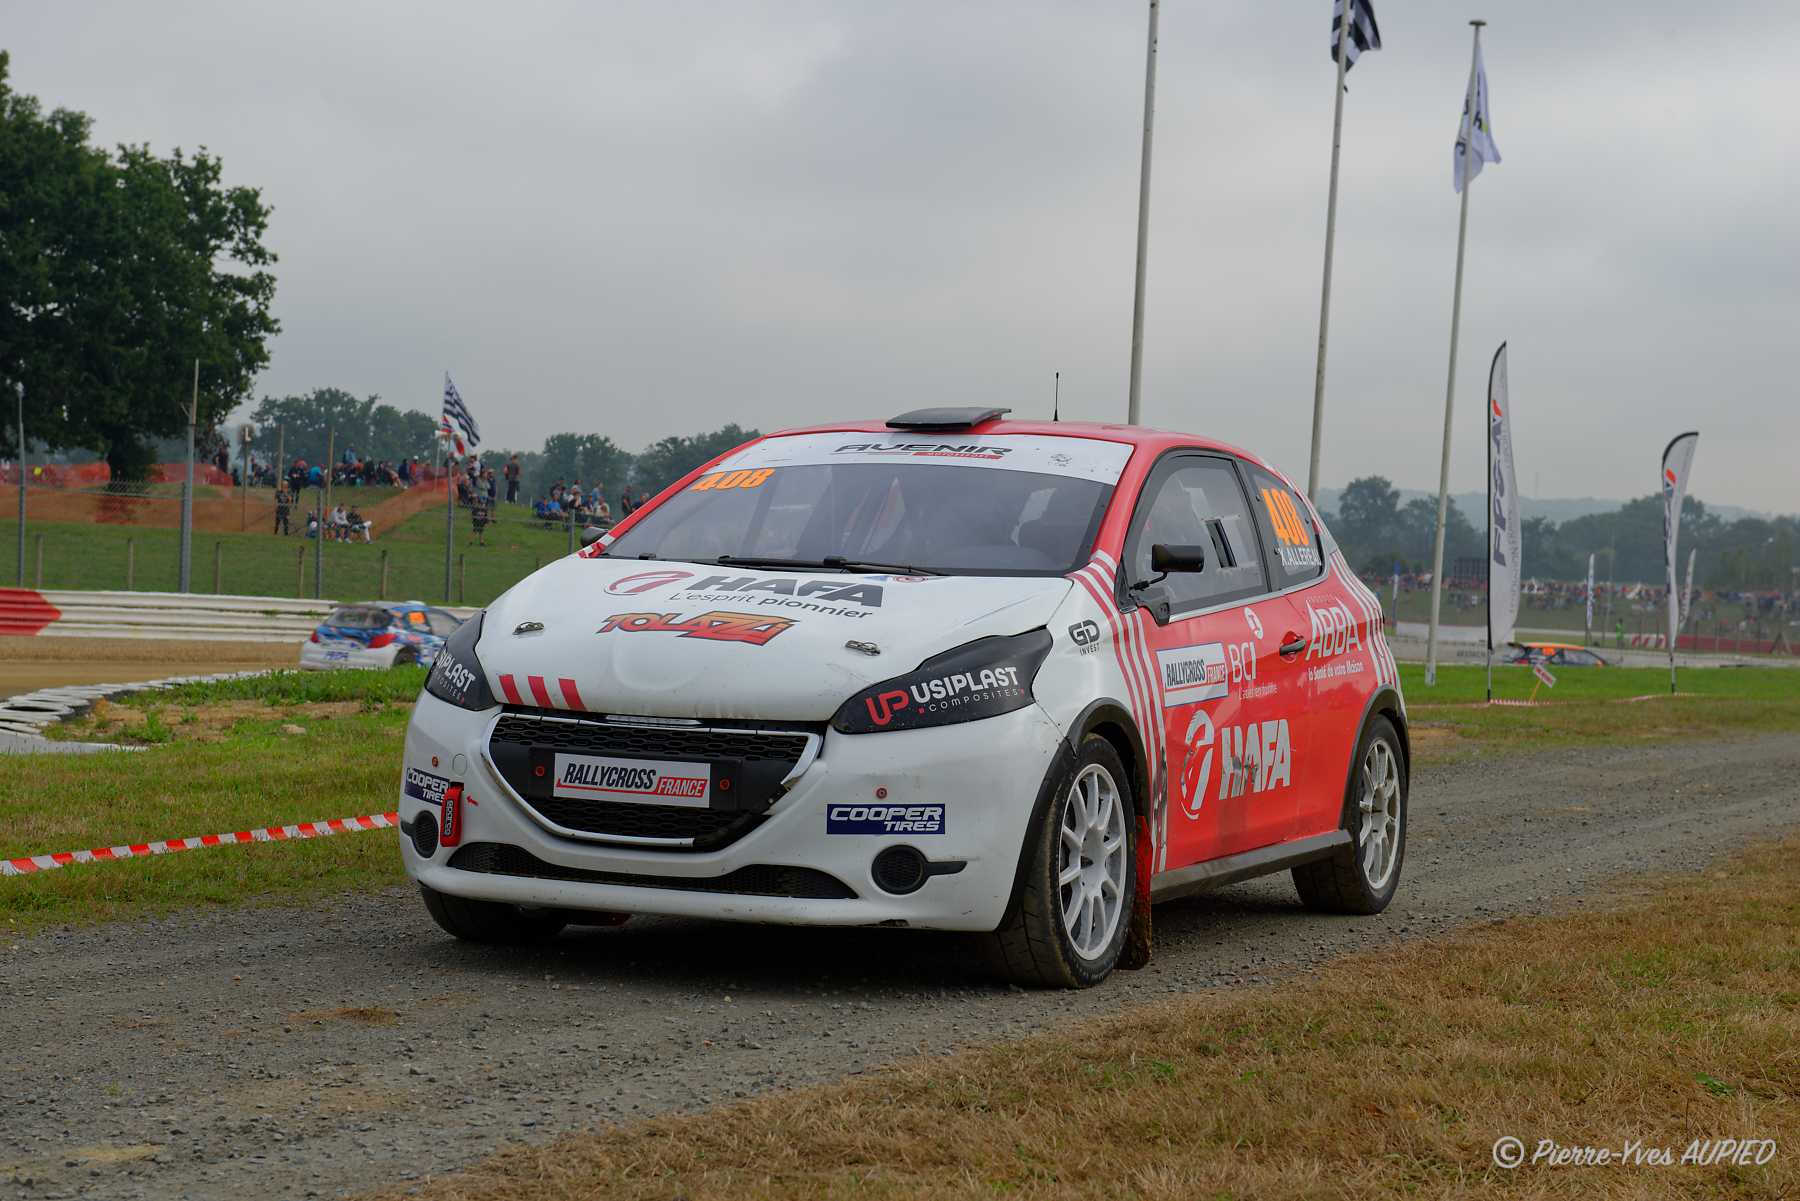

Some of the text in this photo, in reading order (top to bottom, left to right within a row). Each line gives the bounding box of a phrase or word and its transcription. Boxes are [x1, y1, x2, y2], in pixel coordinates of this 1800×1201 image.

[690, 468, 774, 492] 408
[1262, 488, 1311, 546] 408
[668, 591, 873, 619] L'esprit pionnier
[686, 576, 886, 607] HAFA
[1305, 597, 1362, 661] ABBA
[1165, 659, 1226, 687] RALLYCROSS FRANCE
[1228, 641, 1257, 683] BCI
[910, 667, 1019, 704] USIPLAST
[928, 688, 1019, 713] COMPOSITES
[1219, 719, 1291, 801] HAFA
[406, 768, 449, 793] COOPER
[563, 762, 707, 797] RALLYCROSS FRANCE
[830, 806, 943, 821] COOPER
[883, 820, 940, 832] TIRES
